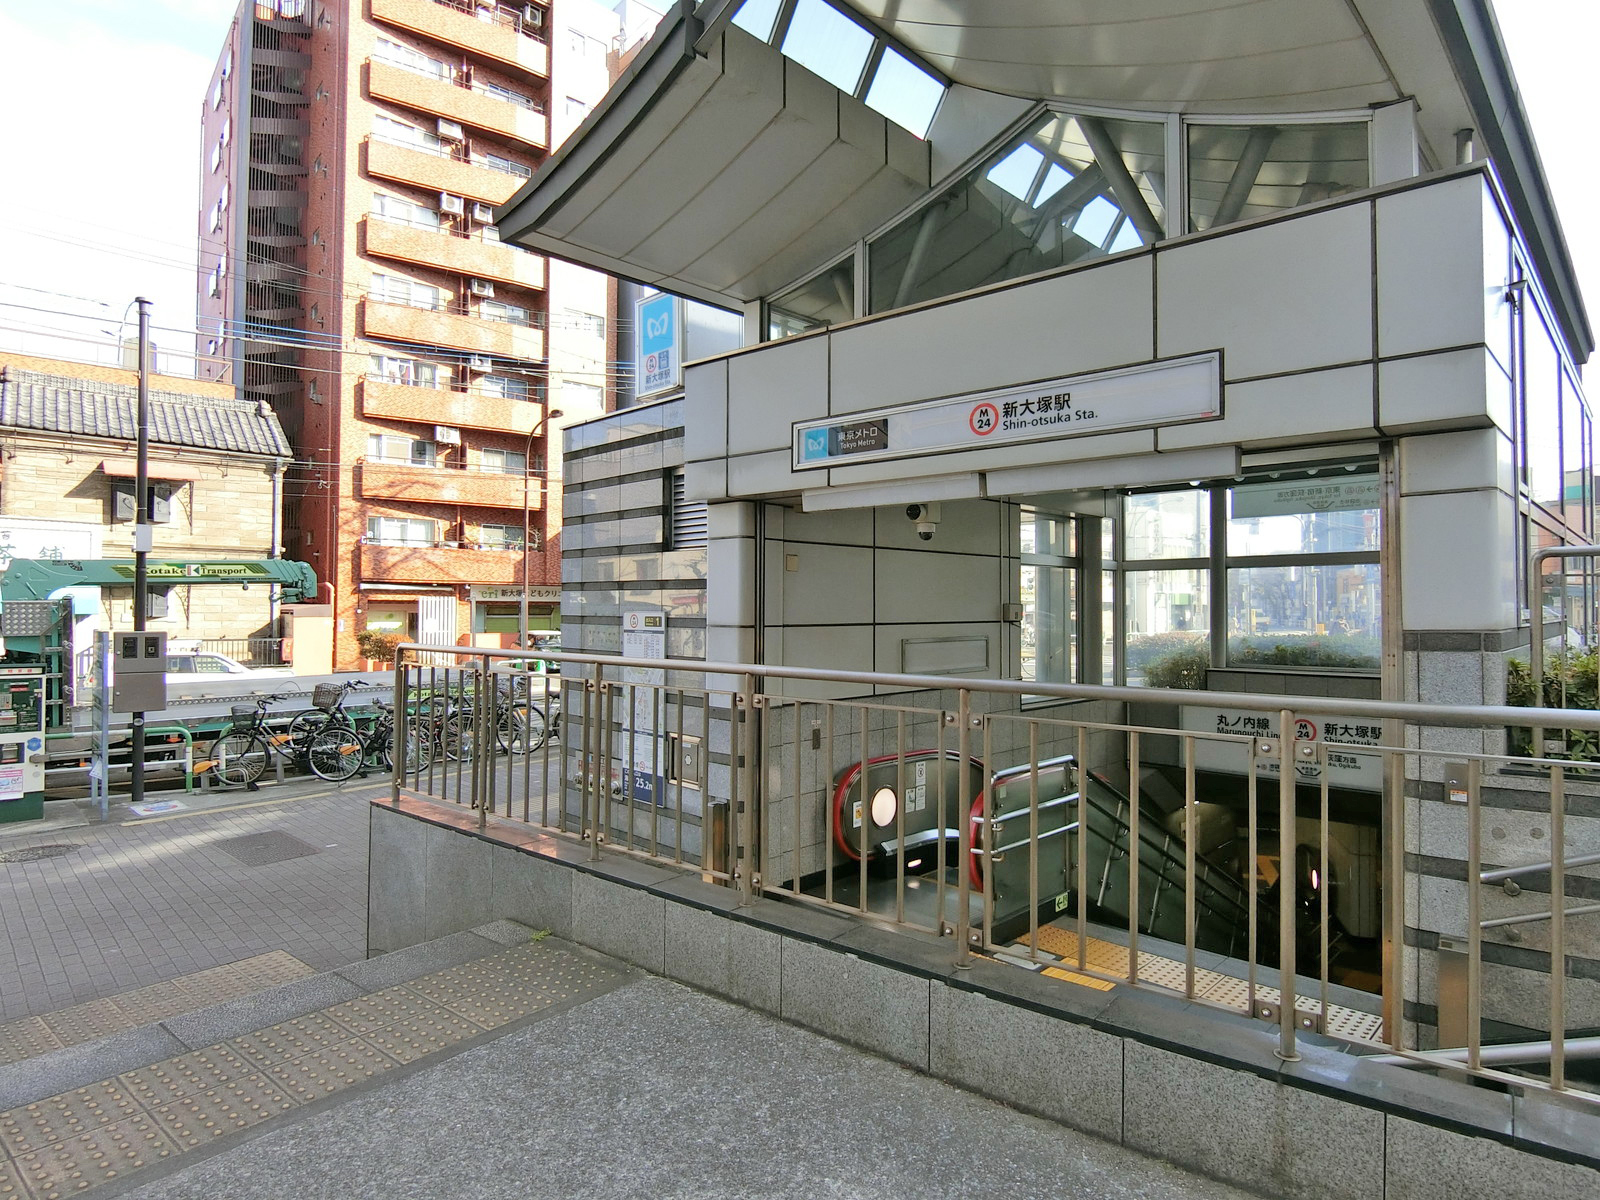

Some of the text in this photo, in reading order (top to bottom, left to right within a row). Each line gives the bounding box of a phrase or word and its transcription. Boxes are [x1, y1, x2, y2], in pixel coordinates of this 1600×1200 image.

[1002, 393, 1071, 419] 新大塚駅
[979, 408, 989, 418] M
[977, 418, 991, 429] 24
[1003, 409, 1098, 431] Shin-otsuka Sta.
[838, 427, 878, 441] 東京メトロ
[840, 439, 876, 450] Tokyo Metro
[201, 567, 247, 575] Transport
[1217, 714, 1270, 730] 丸ノ内線
[1297, 730, 1310, 739] 24
[1324, 723, 1382, 740] 新大塚駅
